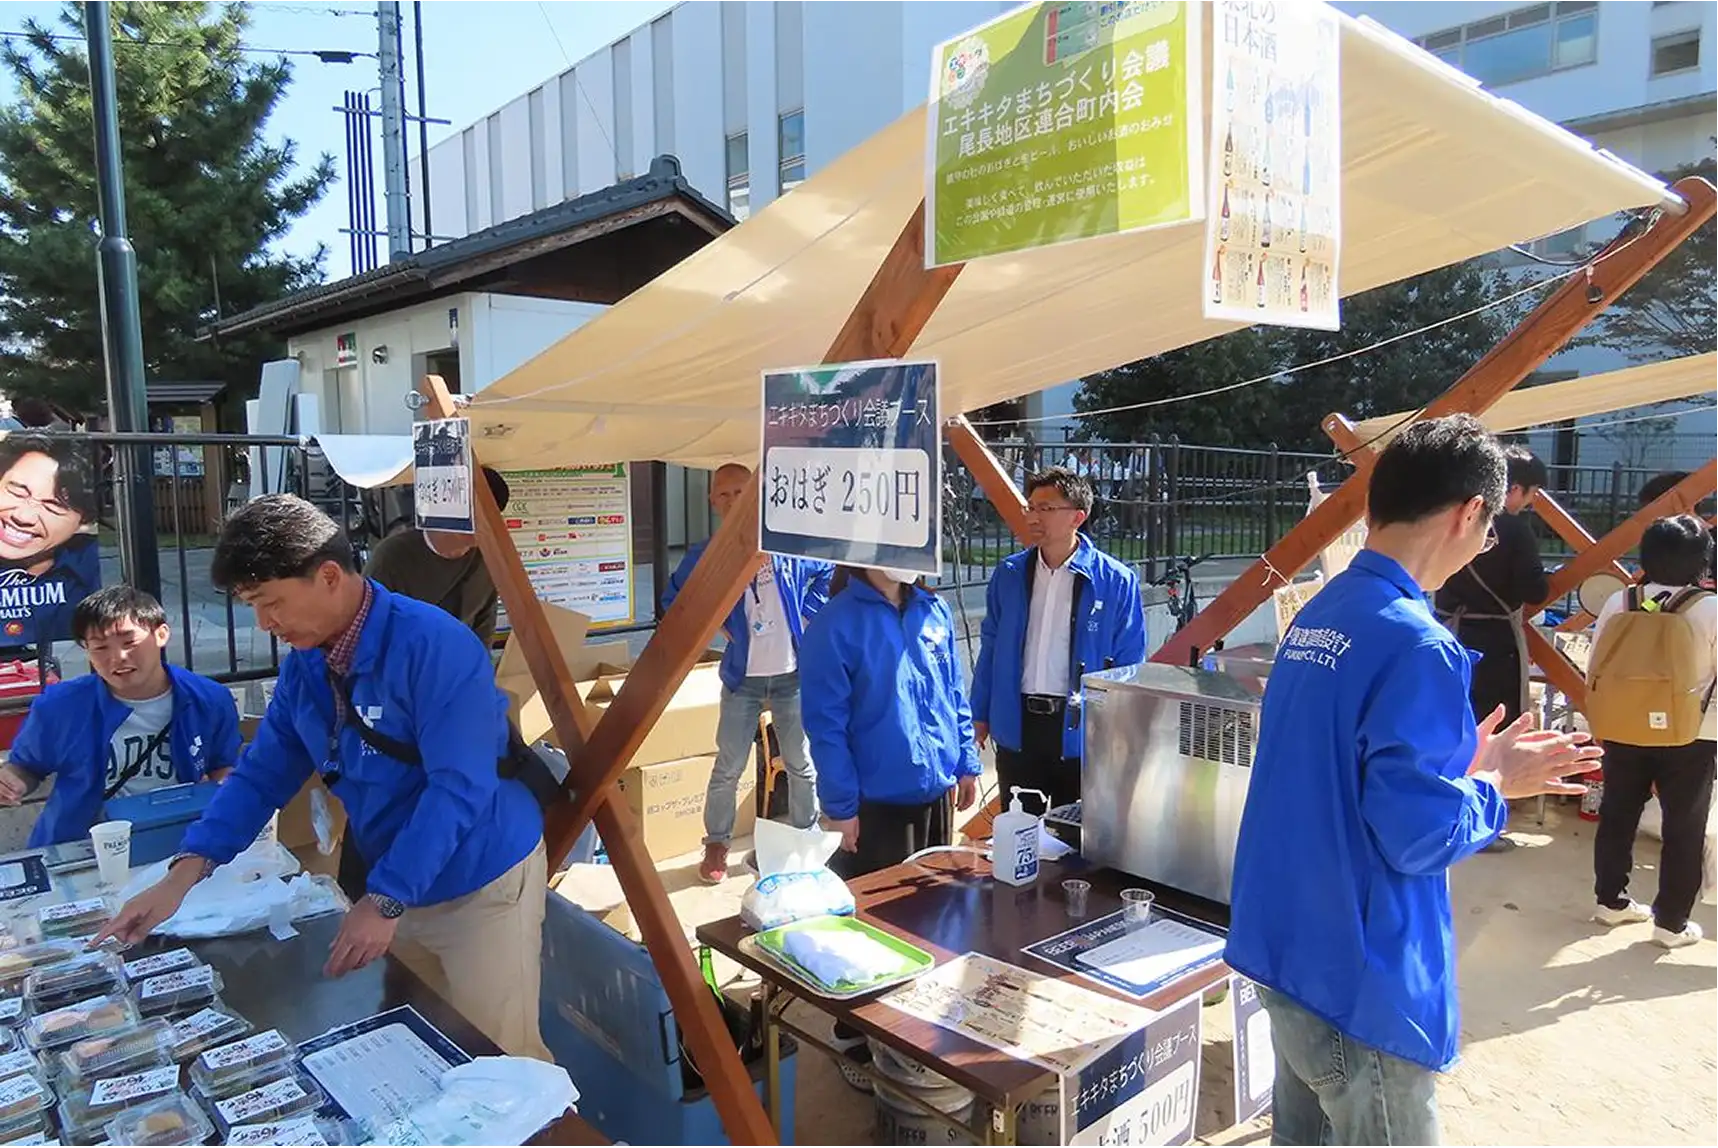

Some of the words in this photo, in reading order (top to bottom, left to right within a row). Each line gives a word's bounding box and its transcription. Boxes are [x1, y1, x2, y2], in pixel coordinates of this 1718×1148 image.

[943, 40, 1169, 136] エキキタまちづくり会議
[958, 81, 1144, 158] 尾長地区連合町内会
[768, 398, 931, 427] エキキタまちづくり会議ブース
[770, 466, 831, 514] おはぎ
[842, 470, 920, 522] 250円
[1071, 1024, 1197, 1116] エキキタまちづくり会議ブース
[1138, 1079, 1189, 1144] 500円
